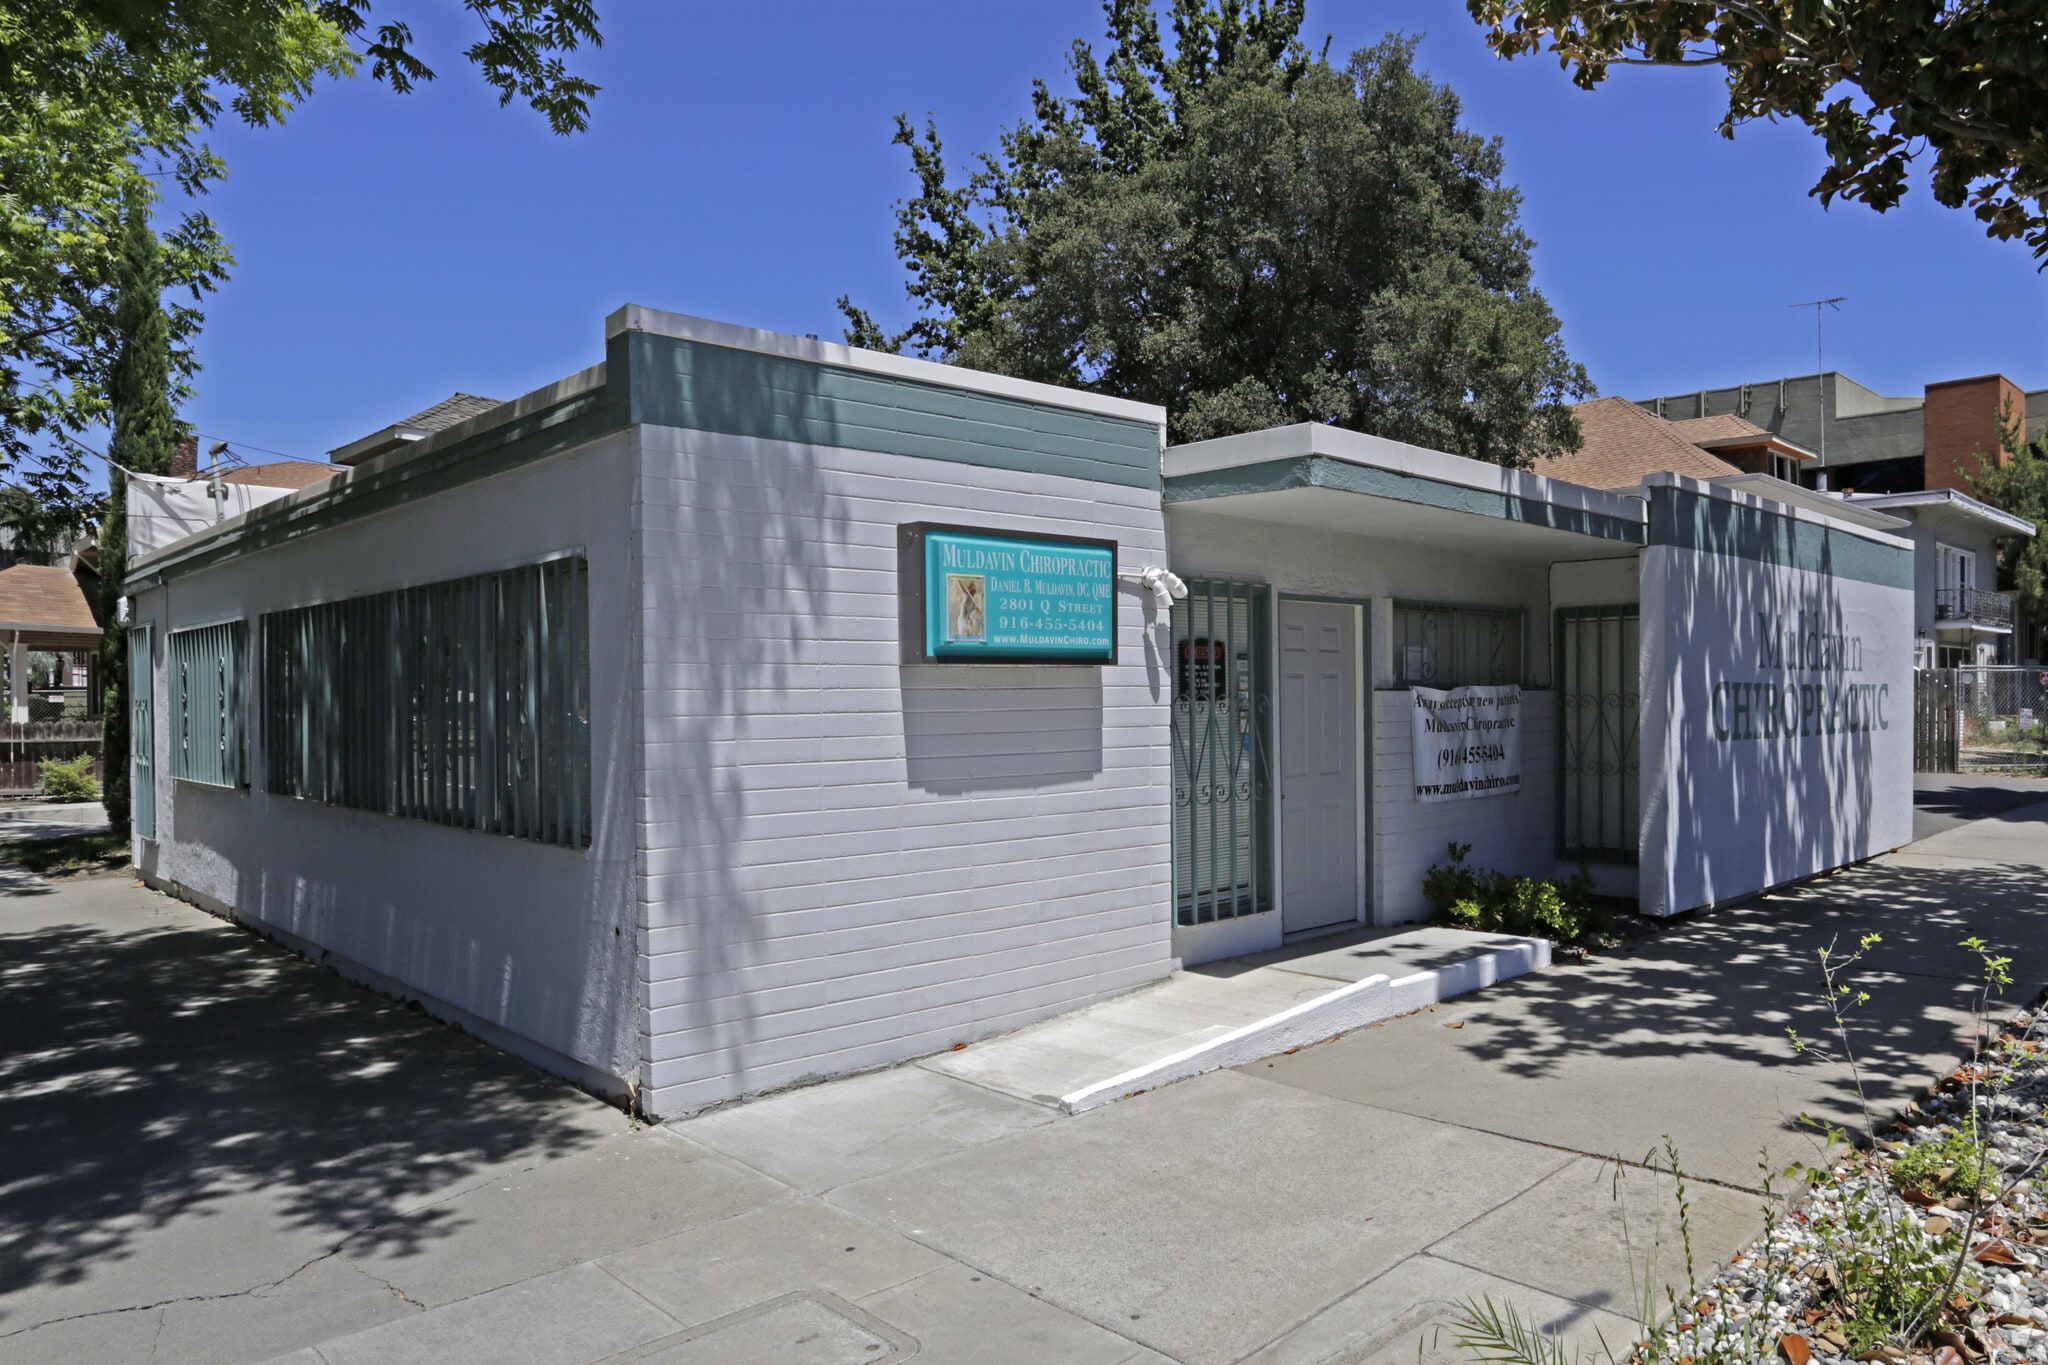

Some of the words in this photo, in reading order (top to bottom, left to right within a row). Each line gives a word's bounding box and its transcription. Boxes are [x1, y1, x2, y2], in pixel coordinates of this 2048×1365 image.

[943, 544, 1015, 571] MULDAVIN
[1019, 550, 1111, 579] CHIROPRACTIC
[991, 576, 1021, 593] DANIEL
[1024, 579, 1032, 593] B.
[1034, 580, 1075, 597] MULDAVIN,
[1077, 582, 1090, 598] DC,
[1092, 583, 1111, 600] QME
[1000, 597, 1034, 611] 2801
[1040, 599, 1050, 614] Q
[1058, 600, 1103, 614] STREET
[999, 617, 1104, 631] 916-455-5404
[1758, 609, 1863, 672] Muldavin
[1186, 646, 1220, 658] COSD
[1477, 696, 1493, 707] new
[1712, 680, 1888, 742] CHIROPRACTIC
